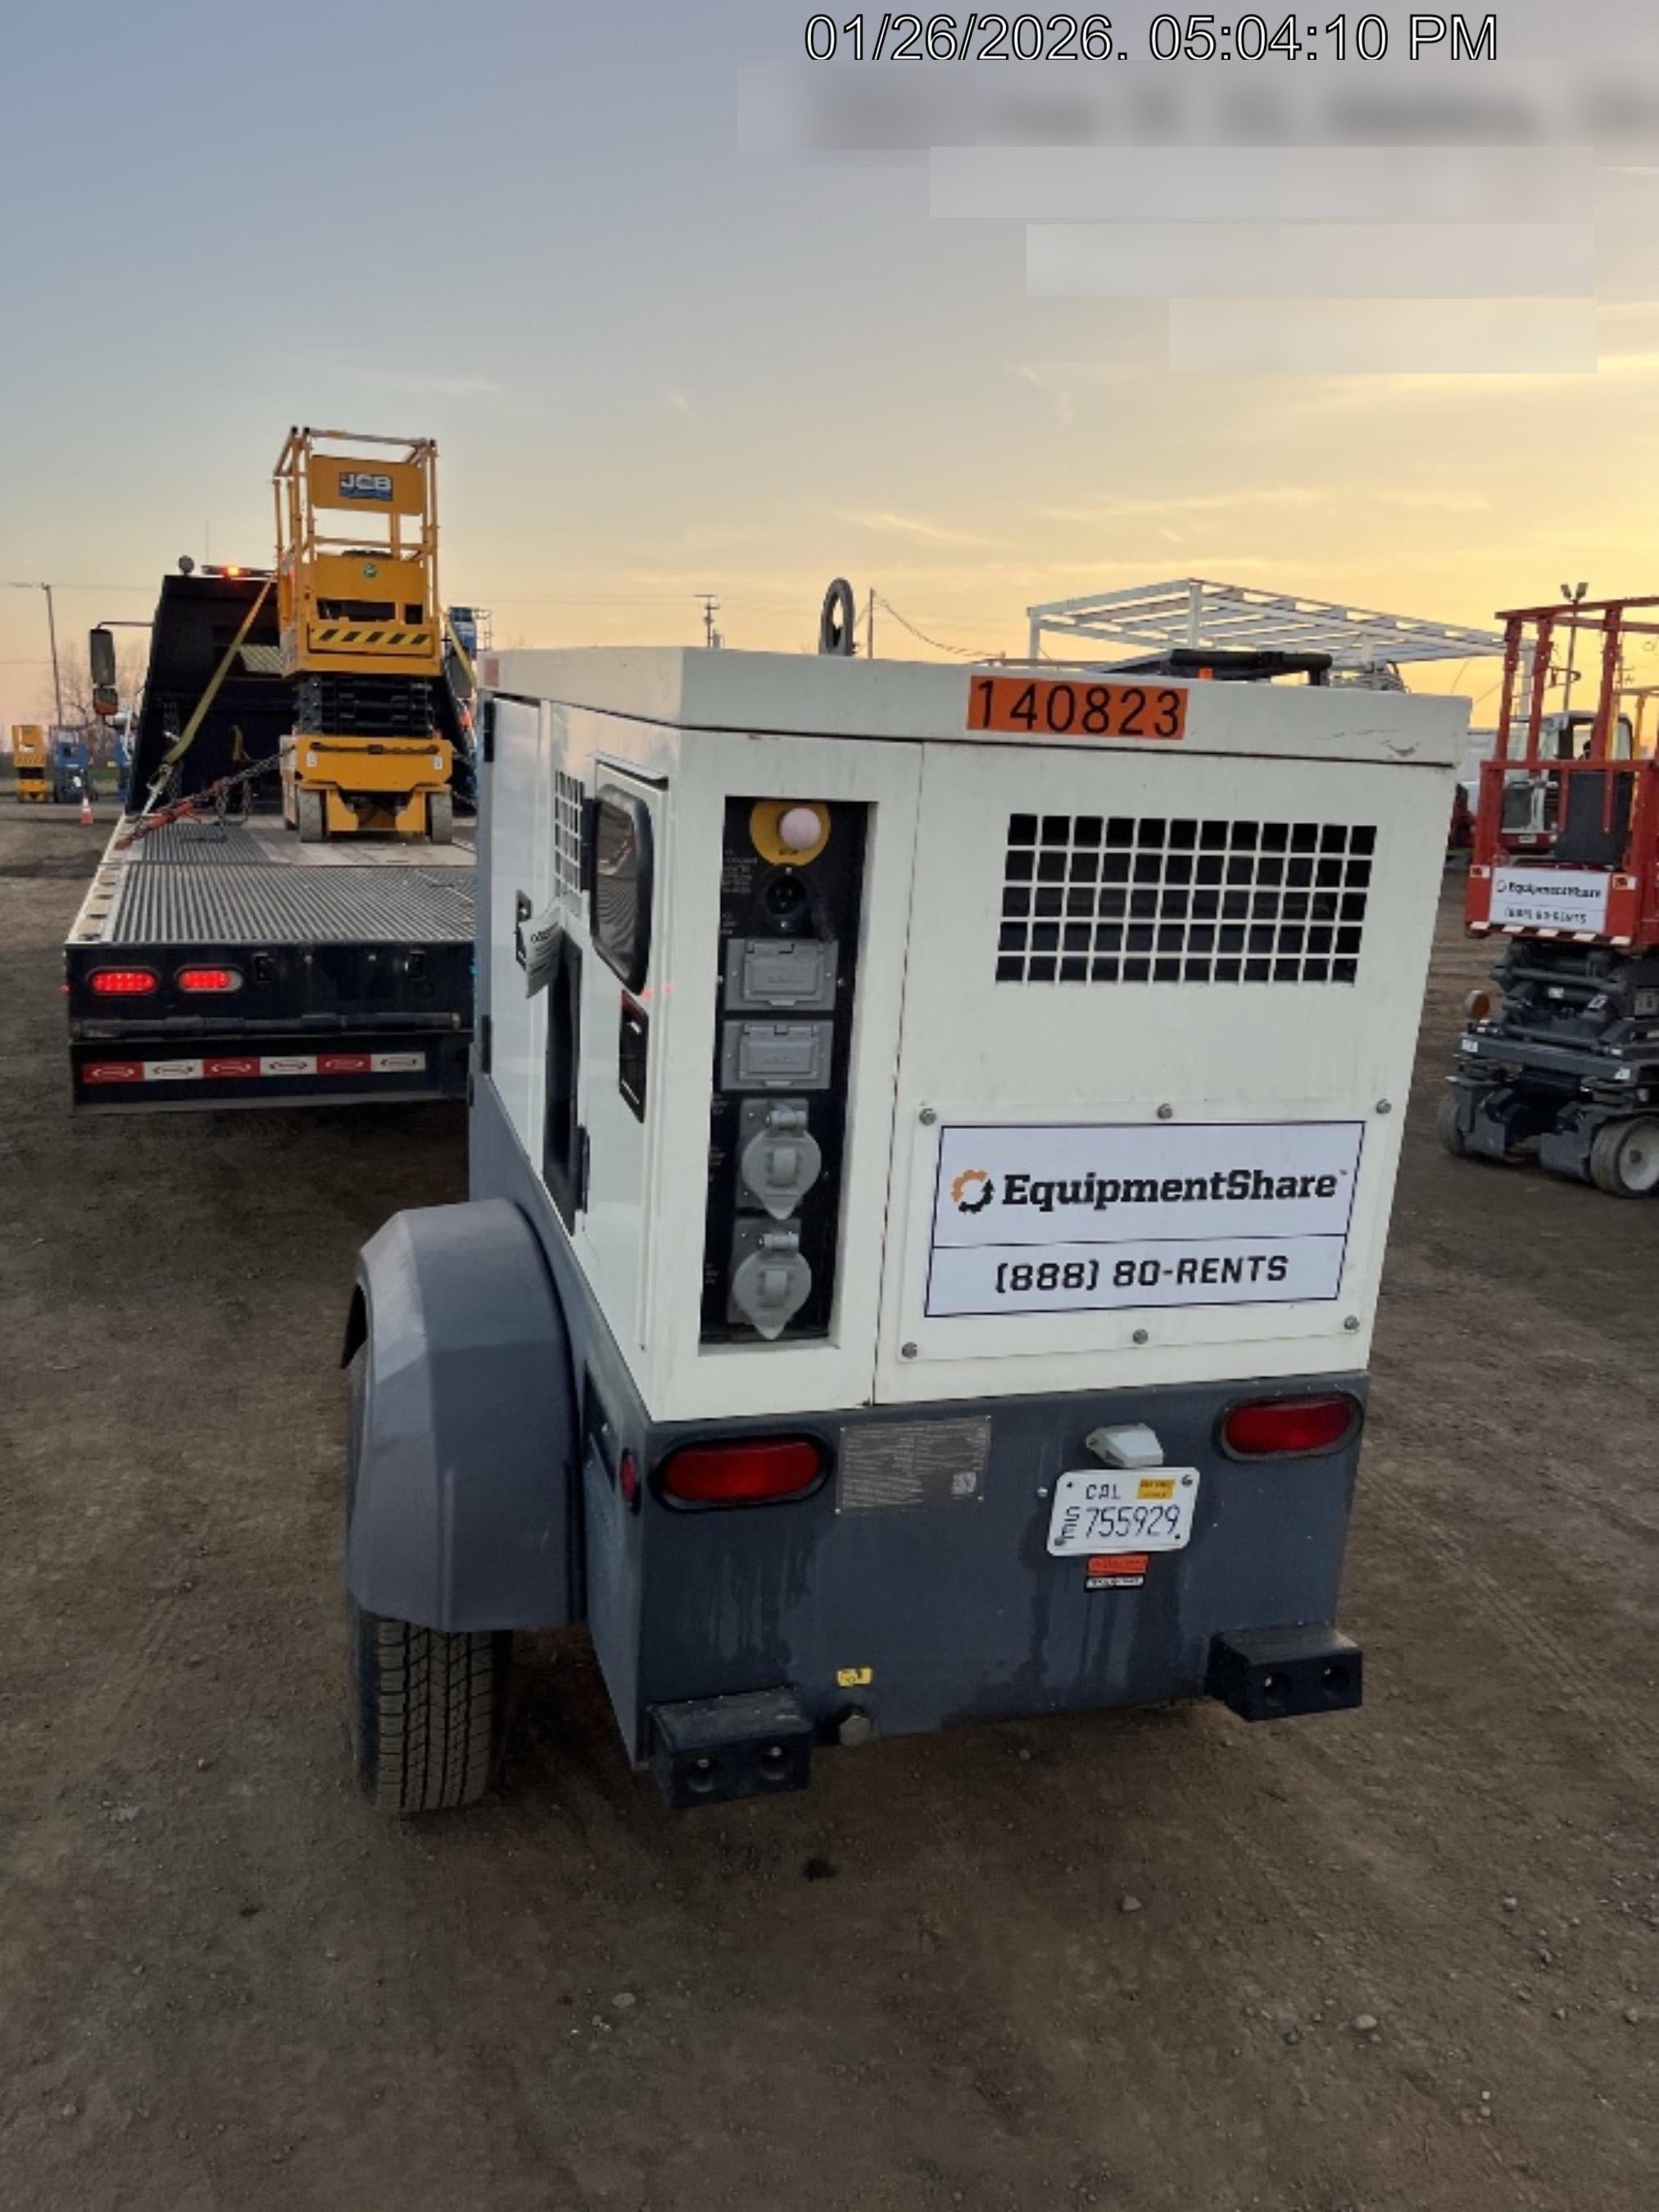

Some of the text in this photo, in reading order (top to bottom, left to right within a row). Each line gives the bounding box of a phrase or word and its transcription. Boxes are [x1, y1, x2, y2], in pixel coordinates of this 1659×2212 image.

[340, 473, 392, 490] JCB
[977, 679, 1181, 737] 140823
[1001, 1169, 1338, 1213] EquipmentShare
[995, 1255, 1290, 1294] (888) 80-RENTS
[1086, 1484, 1122, 1500] CAL
[1086, 1504, 1181, 1539] 755929
